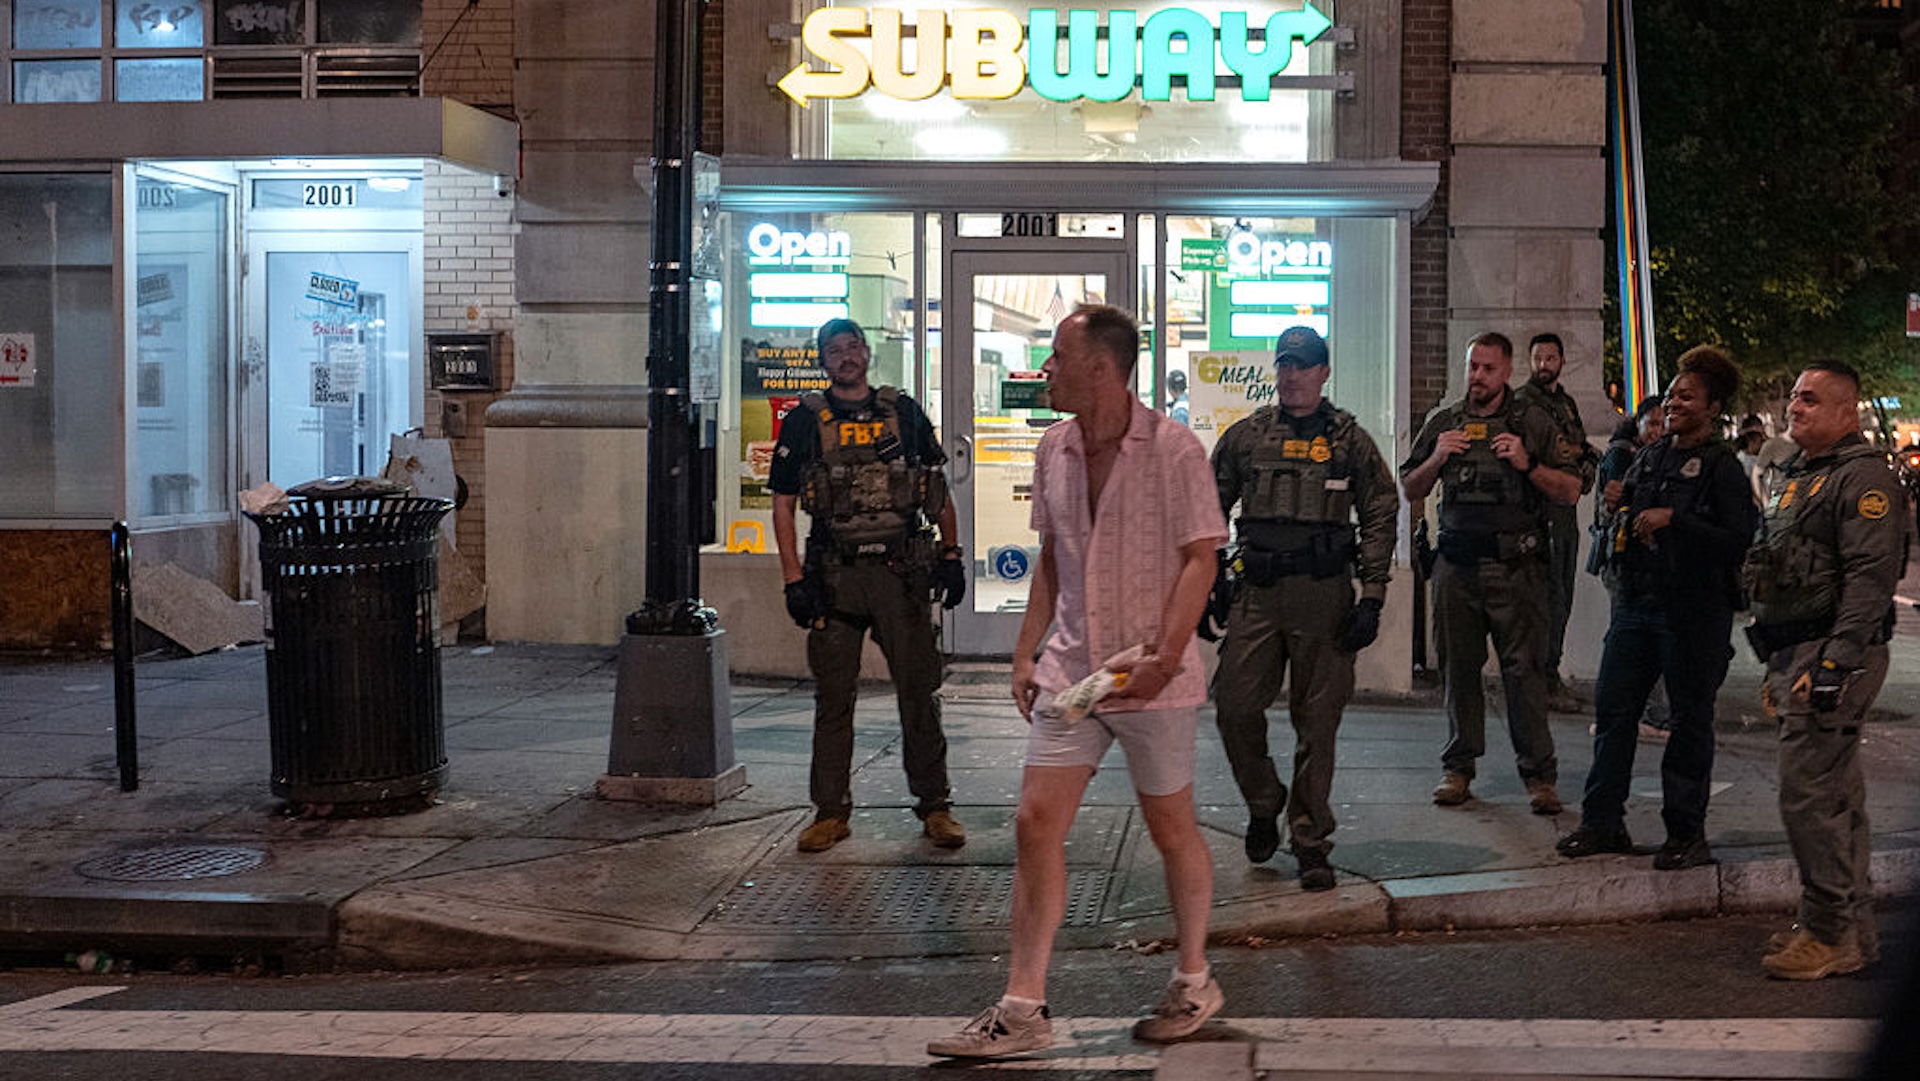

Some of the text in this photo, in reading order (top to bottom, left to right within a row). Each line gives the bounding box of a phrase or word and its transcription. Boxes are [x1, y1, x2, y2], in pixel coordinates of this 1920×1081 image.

[778, 3, 1331, 107] SUBWAY
[305, 185, 353, 206] 2001
[1002, 214, 1057, 237] 2001
[749, 223, 850, 265] Open
[1229, 231, 1332, 274] Open
[757, 348, 781, 358] BUY
[783, 348, 806, 358] ANY
[763, 379, 785, 389] FOR
[1218, 365, 1264, 385] MEAL
[1247, 382, 1278, 404] DAY
[839, 421, 885, 447] FBI
